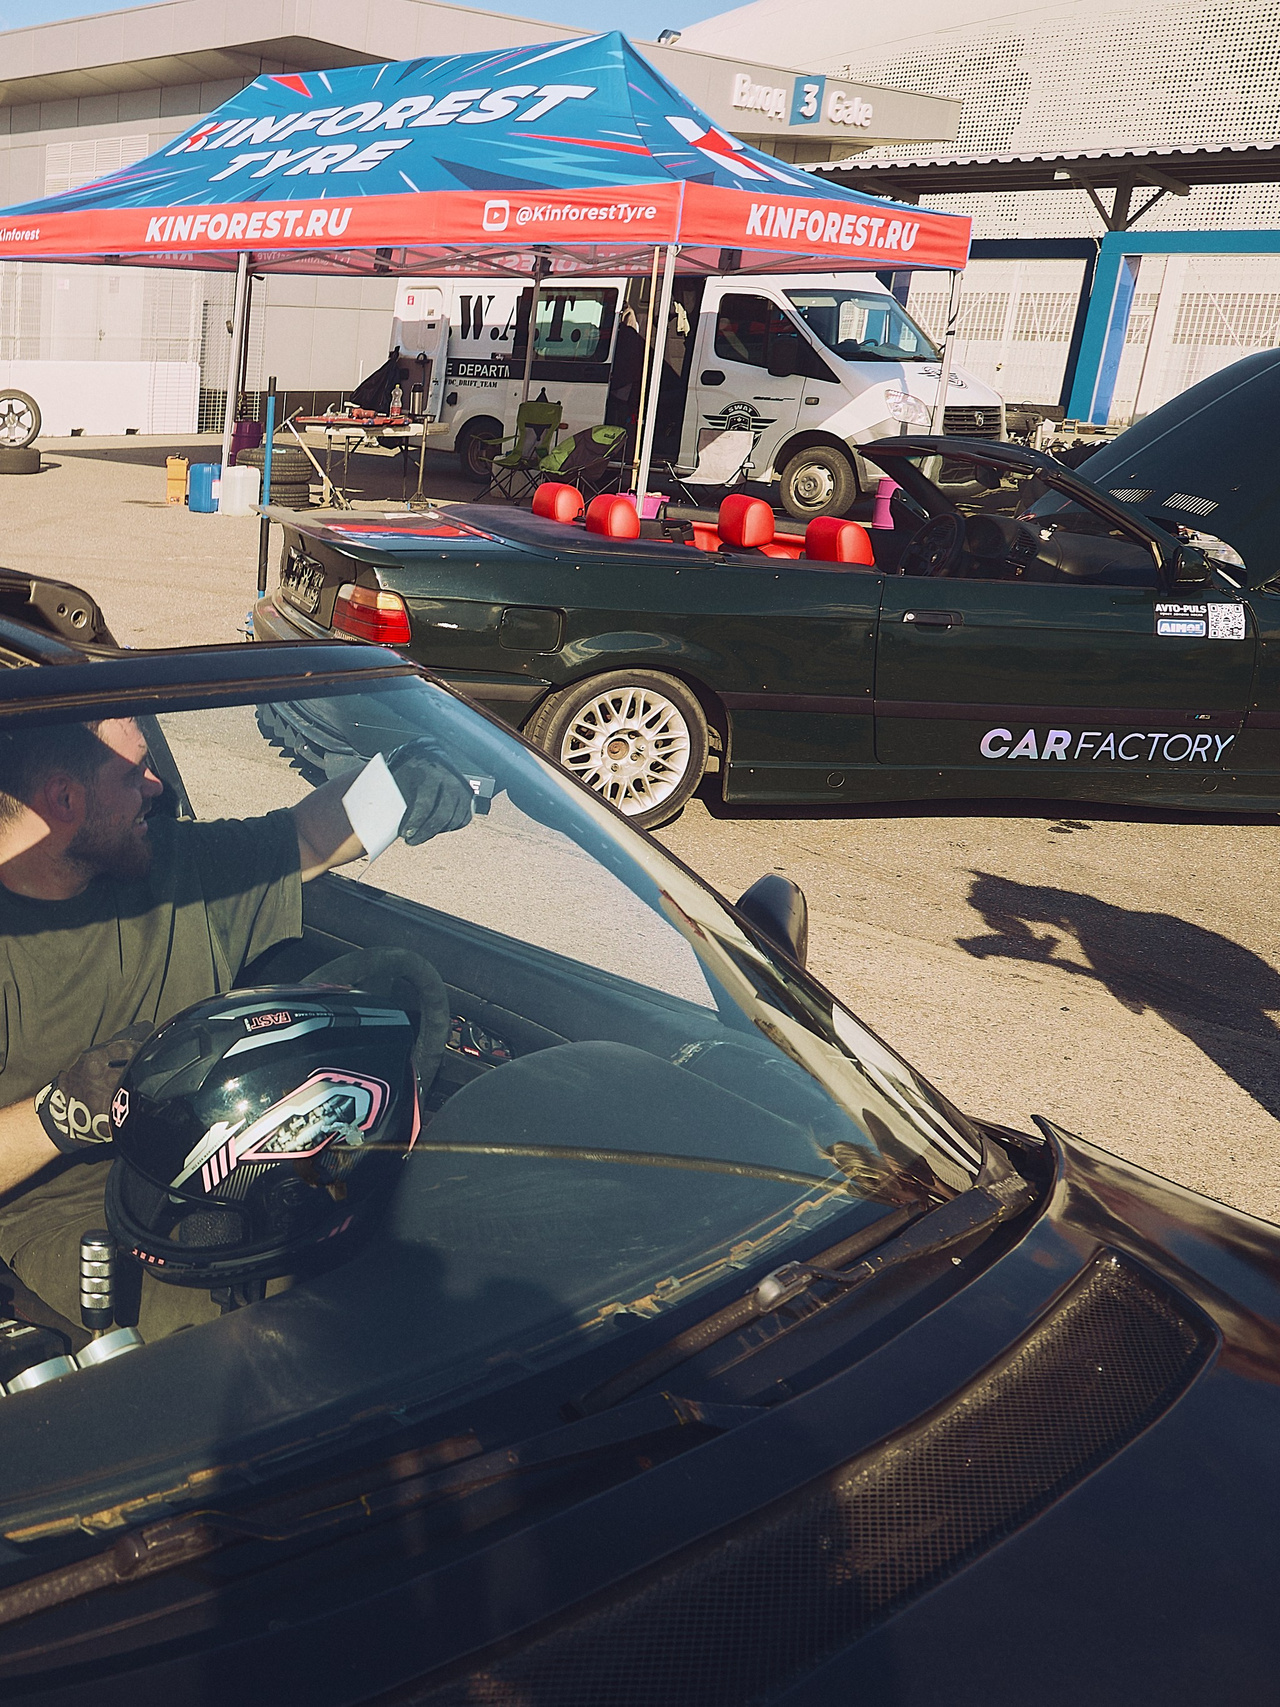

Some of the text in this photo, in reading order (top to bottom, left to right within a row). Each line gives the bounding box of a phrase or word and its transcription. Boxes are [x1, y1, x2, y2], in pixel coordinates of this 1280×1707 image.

[732, 73, 873, 126] Вход 3 Gate
[165, 85, 598, 157] KINFOREST
[209, 138, 414, 182] TYRE
[145, 207, 353, 243] KINFOREST.RU
[516, 203, 657, 225] @KinforestTyre
[745, 203, 920, 251] KINFOREST.RU
[728, 404, 753, 413] SWAT
[1155, 603, 1207, 613] AVTO-PULS
[1160, 622, 1203, 634] AIMOL
[251, 1011, 291, 1030] FAST
